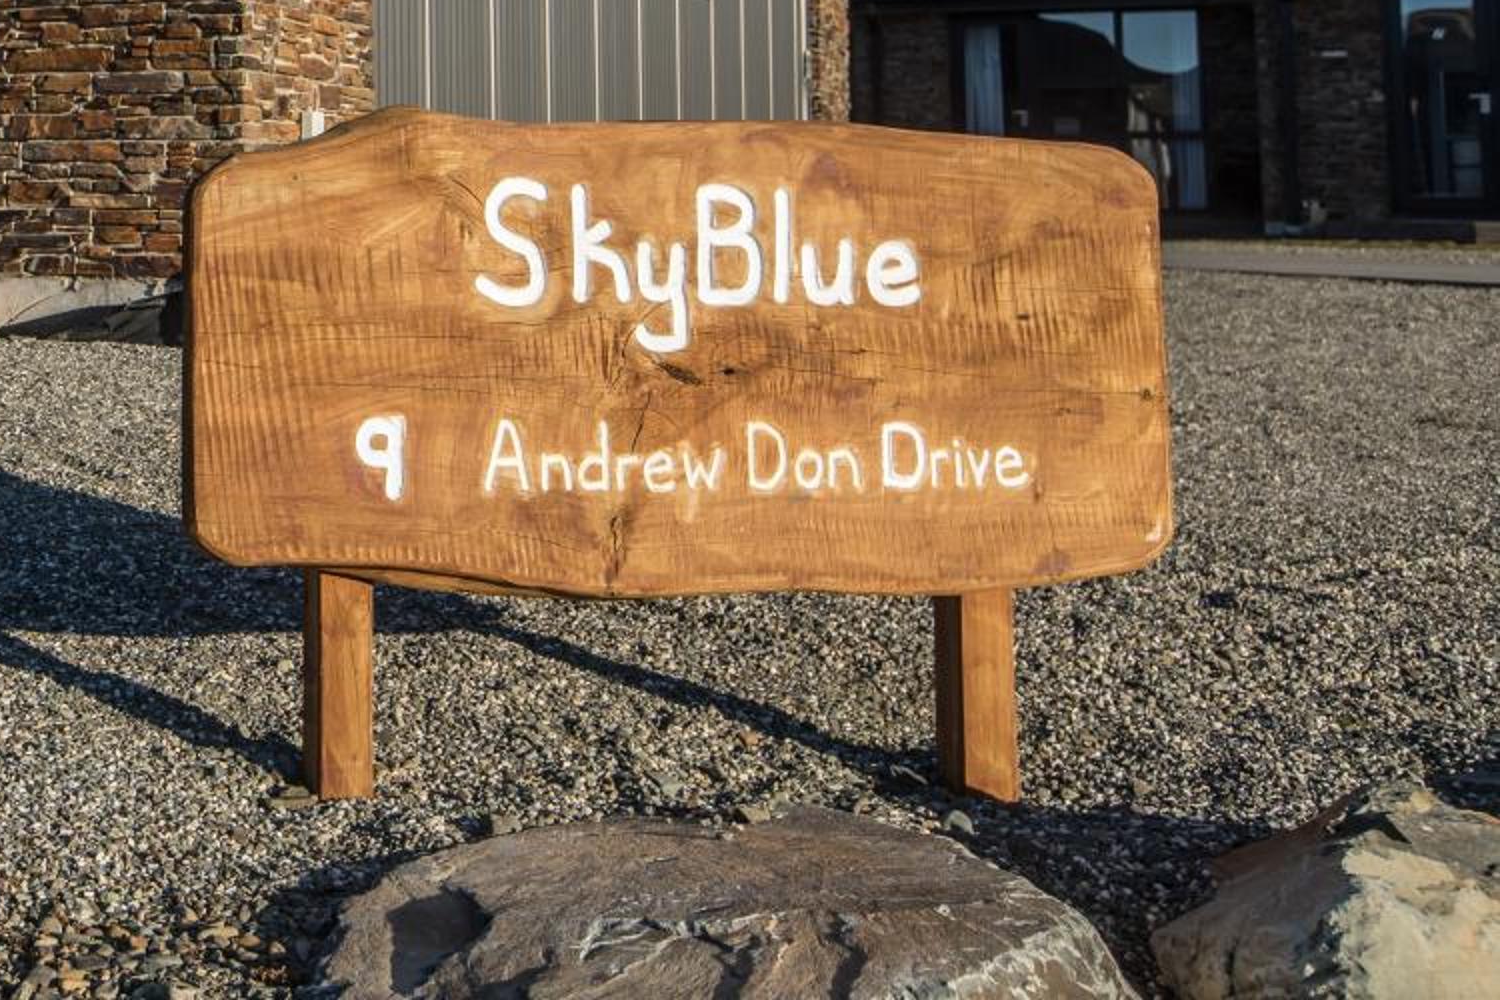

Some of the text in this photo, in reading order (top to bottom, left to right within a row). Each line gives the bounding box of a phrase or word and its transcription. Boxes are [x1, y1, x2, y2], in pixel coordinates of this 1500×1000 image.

[473, 175, 923, 354] SkyBlue
[354, 414, 1031, 501] 9 Andrew Don Drive
